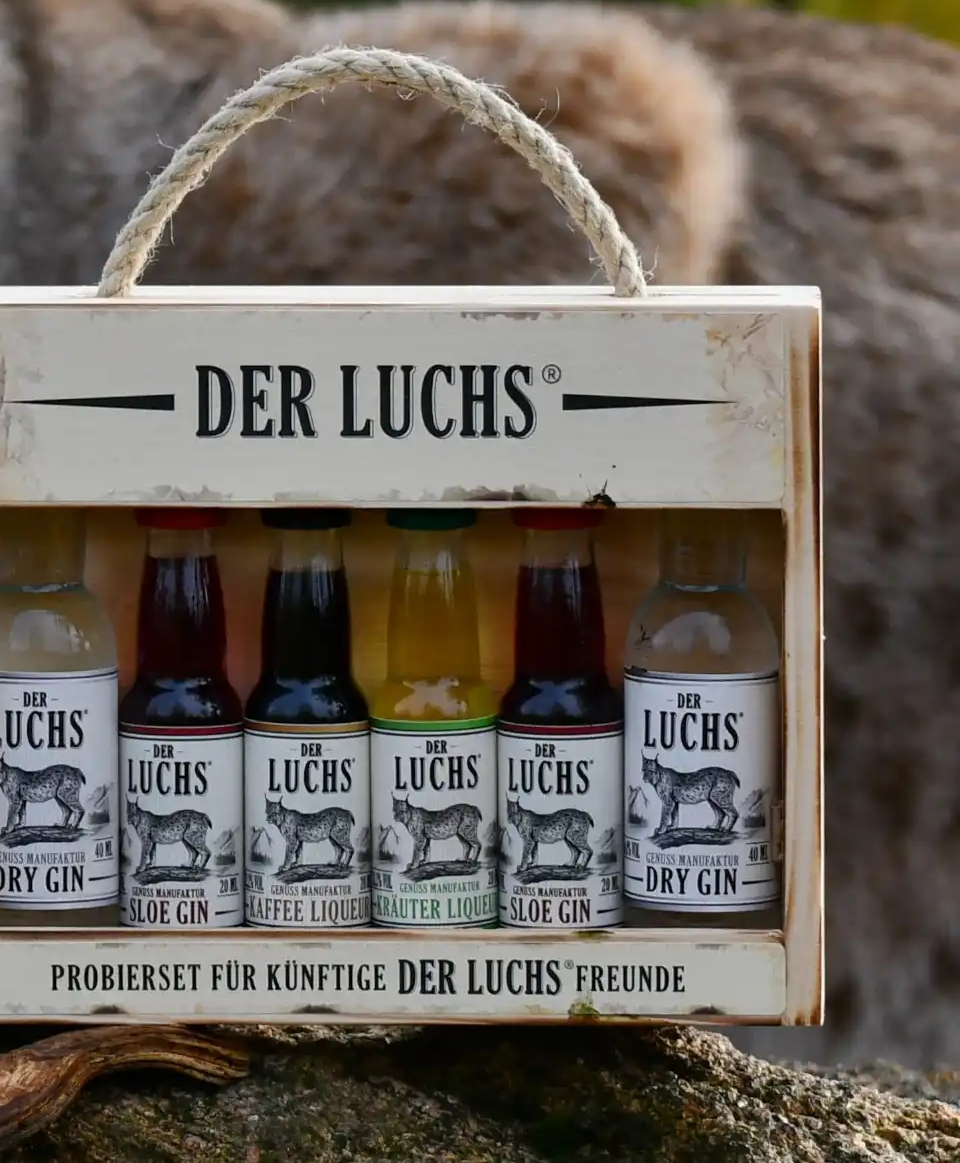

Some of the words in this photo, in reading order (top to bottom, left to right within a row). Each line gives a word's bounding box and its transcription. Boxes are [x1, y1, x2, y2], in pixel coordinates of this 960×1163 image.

[195, 364, 318, 438] DER
[23, 691, 48, 708] DER
[677, 692, 702, 710] DER
[153, 744, 174, 759] DER
[301, 742, 322, 757] DER
[426, 739, 448, 755] DER
[535, 743, 556, 758] DER
[26, 851, 86, 865] MANUFAKTUR
[95, 844, 103, 858] 40
[748, 847, 758, 862] 40
[646, 852, 676, 866] GENUSS
[678, 853, 739, 867] MANUFAKTUR
[45, 864, 84, 894] GIN
[220, 879, 229, 893] 20
[601, 878, 610, 893] 20
[646, 865, 690, 895] DRY
[697, 867, 737, 896] GIN
[132, 886, 154, 898] GENUSS
[155, 887, 205, 899] MANUFAKTUR
[270, 884, 299, 897] GENUSS
[301, 884, 352, 897] MANUFAKTUR
[399, 882, 428, 894] GENUSS
[429, 880, 481, 894] MANUFAKTUR
[512, 885, 536, 897] GENUSS
[537, 887, 588, 898] MANUFAKTUR
[129, 897, 171, 924] SLOE
[176, 899, 209, 925] GIN
[249, 895, 304, 922] KAFFEE
[310, 895, 370, 925] LIQUEUR
[376, 893, 441, 920] KRÄUTER
[510, 896, 553, 924] SLOE
[559, 898, 591, 924] GIN
[51, 964, 201, 991] PROBIERSET
[211, 959, 257, 991] FÜR
[266, 959, 387, 992] KÜNFTIGE
[397, 959, 457, 995] DER
[575, 964, 686, 993] FREUNDE
